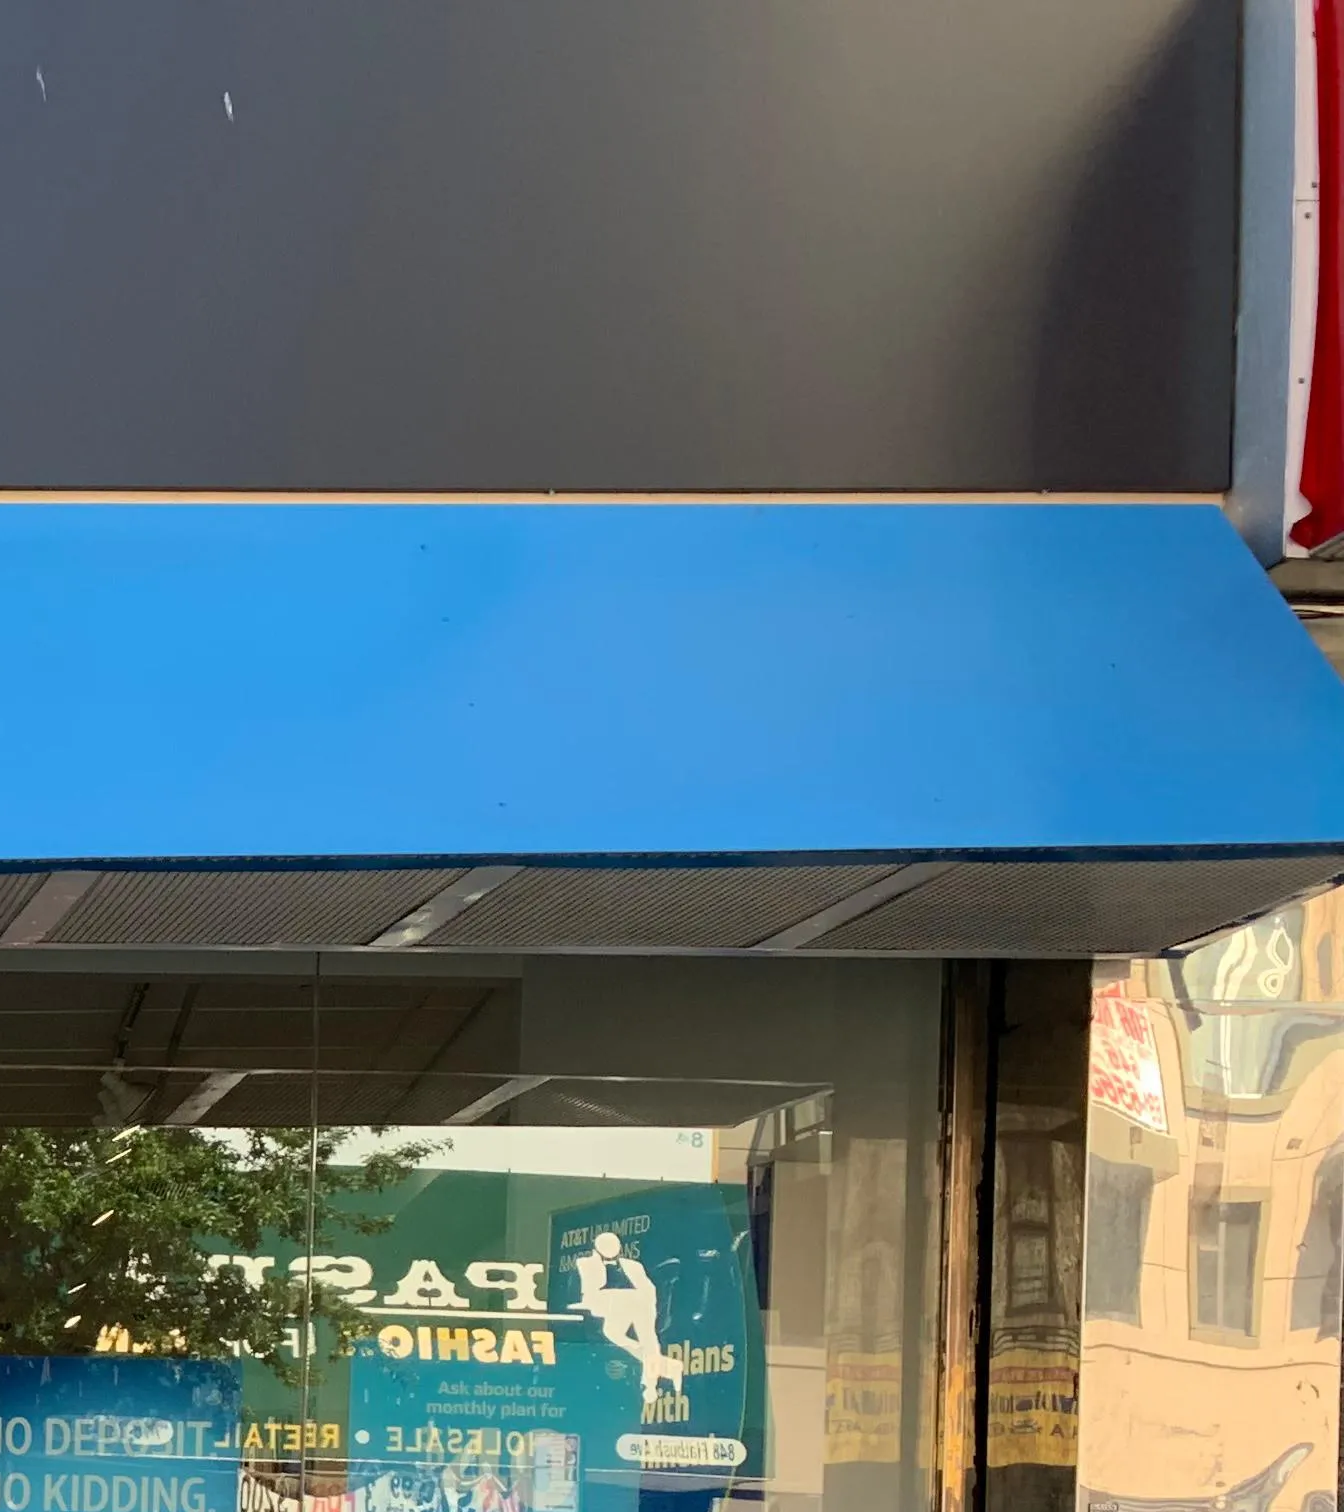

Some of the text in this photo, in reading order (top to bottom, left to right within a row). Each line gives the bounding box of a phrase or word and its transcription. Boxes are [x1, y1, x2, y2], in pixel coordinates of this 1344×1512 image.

[438, 1380, 556, 1399] Ask about our
[426, 1400, 567, 1420] monthly plan for
